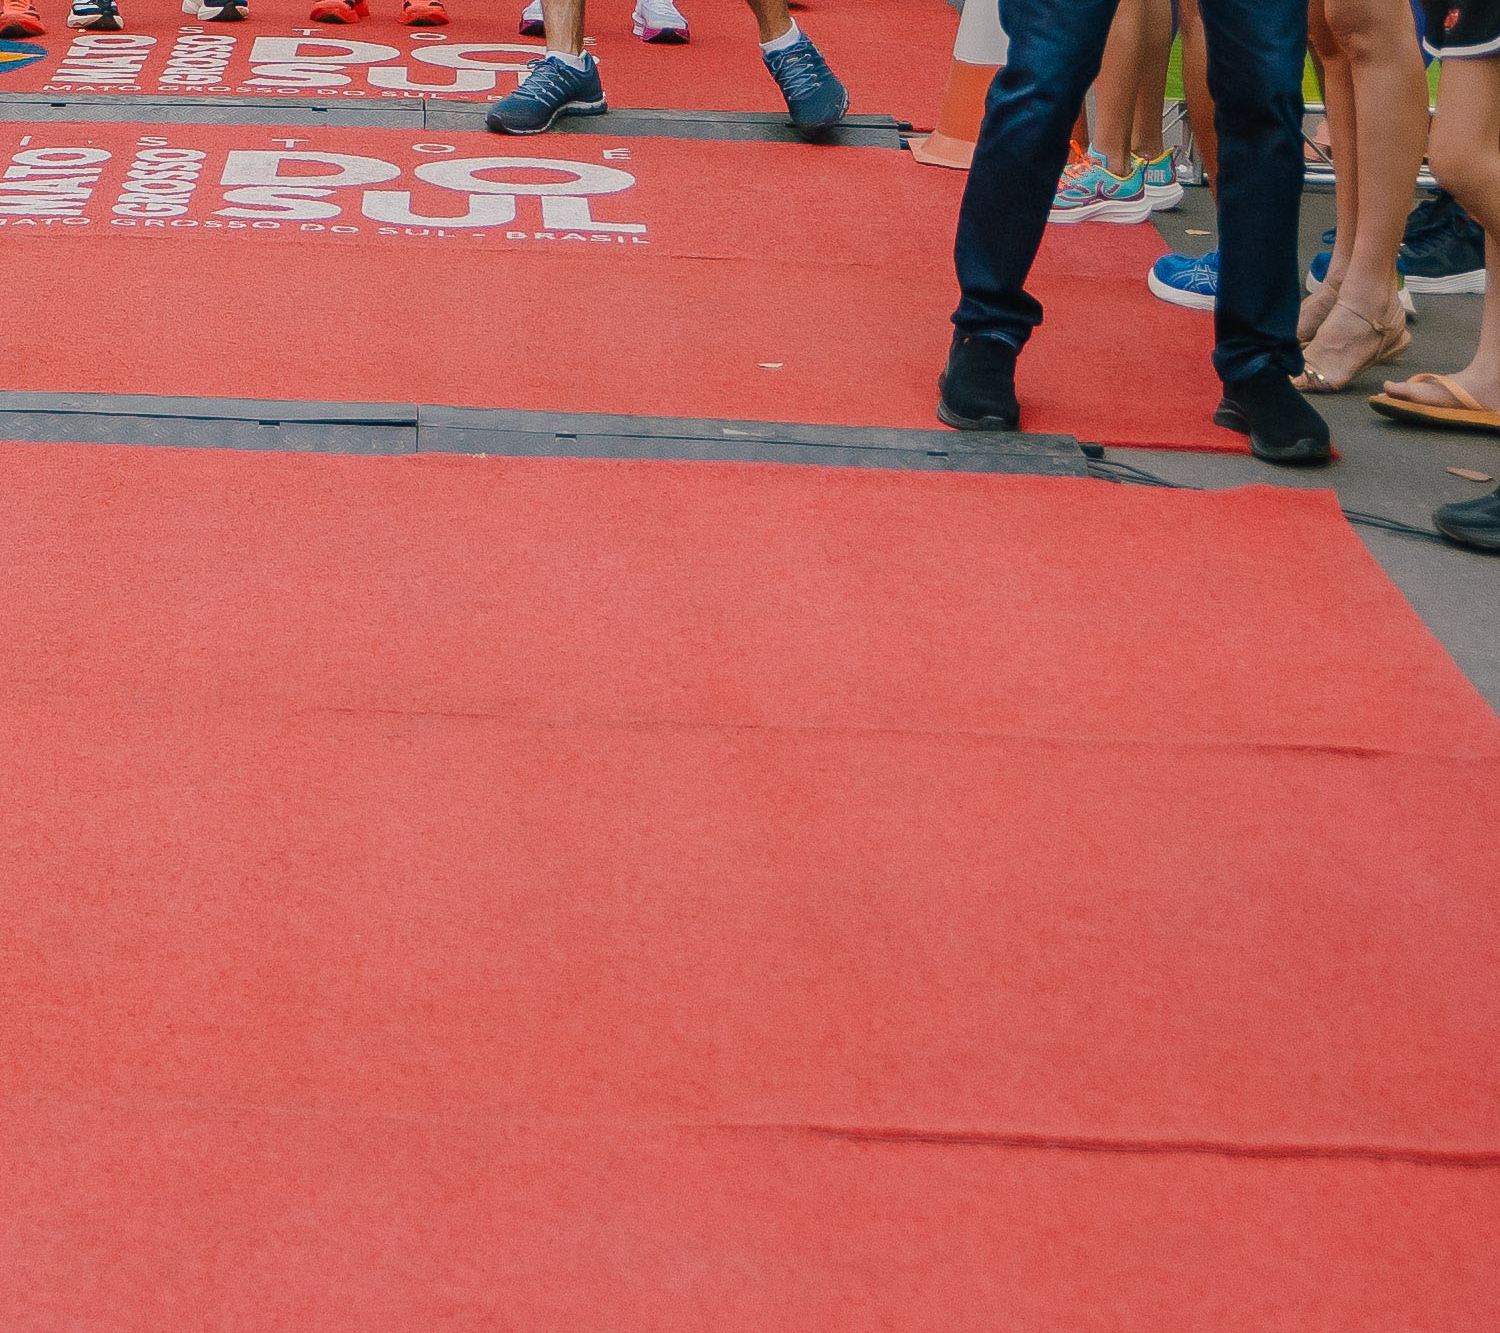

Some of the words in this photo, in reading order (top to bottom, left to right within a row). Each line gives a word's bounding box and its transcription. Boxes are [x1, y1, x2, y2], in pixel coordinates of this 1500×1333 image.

[51, 34, 158, 85] MATO
[158, 34, 238, 85] GROSSO
[42, 84, 142, 92] MATO
[158, 85, 300, 95] GROSSO
[318, 89, 366, 97] DO
[381, 91, 437, 100] SUL
[111, 148, 208, 217] GROSSO
[220, 150, 636, 196] DO
[110, 218, 281, 229] GROSSO
[301, 223, 349, 232] DO
[378, 227, 456, 238] SUL
[506, 231, 652, 245] BRASIL
[212, 186, 647, 233] SUL
